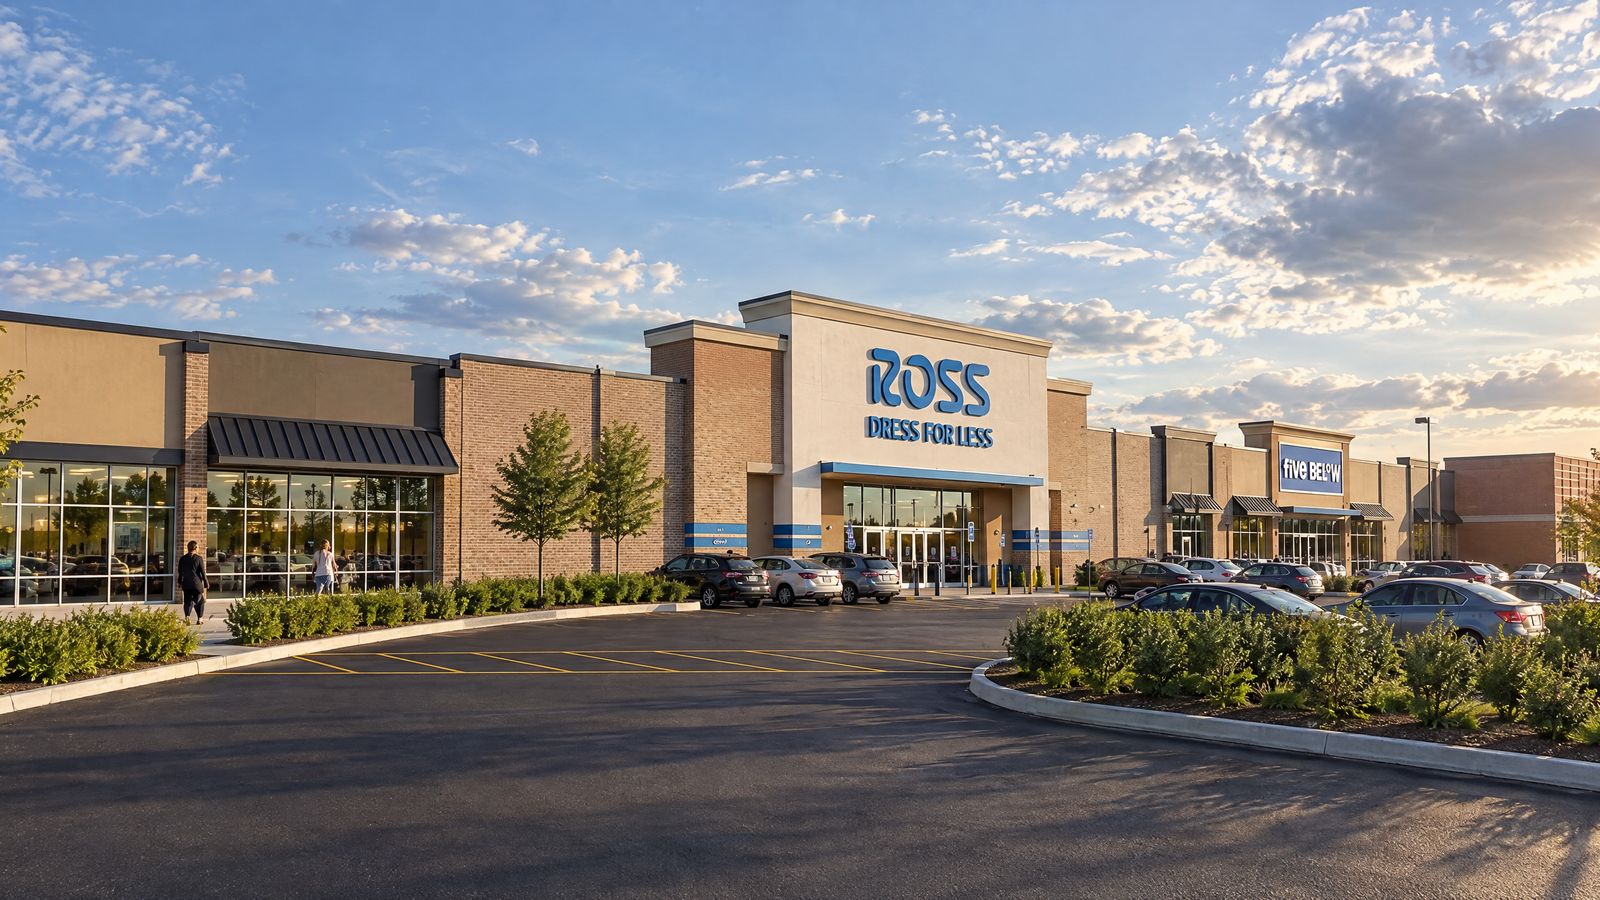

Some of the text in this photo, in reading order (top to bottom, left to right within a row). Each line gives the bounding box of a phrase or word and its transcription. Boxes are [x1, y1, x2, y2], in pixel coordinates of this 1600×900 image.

[869, 347, 991, 417] ROSS
[867, 415, 994, 448] DRESS FOR LESS
[1283, 457, 1341, 483] five BELOW
